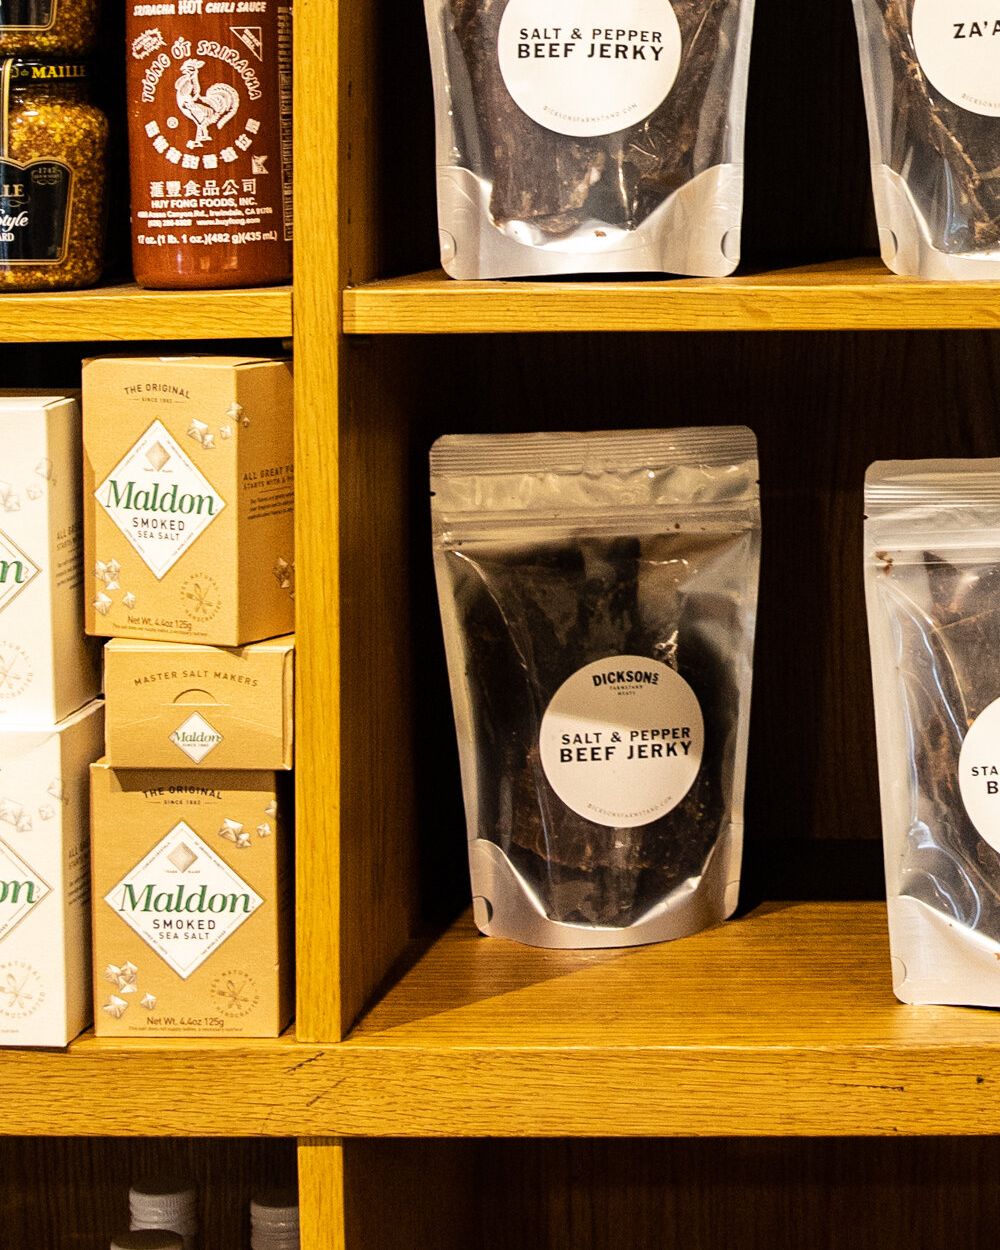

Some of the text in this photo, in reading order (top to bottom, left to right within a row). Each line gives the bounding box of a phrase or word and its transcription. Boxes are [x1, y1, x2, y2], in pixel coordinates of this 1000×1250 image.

[178, 0, 203, 15] HOT
[205, 2, 235, 14] CHILI
[236, 1, 267, 12] SAUCE
[519, 28, 662, 43] SALT & PEPPER
[517, 43, 664, 61] BEEF JERKY
[197, 40, 262, 100] SRIRACHA
[151, 197, 258, 209] HUY FONG FOODS, INC.
[167, 234, 179, 244] lb.
[181, 234, 187, 243] 1
[124, 383, 191, 399] THE ORIGINAL
[243, 467, 283, 481] ALL GREAT
[106, 480, 215, 516] Maldon
[132, 518, 185, 531] SMOKED
[159, 532, 180, 541] SALT
[128, 616, 140, 624] Net
[175, 619, 192, 631] 125g
[134, 670, 258, 687] MASTER SALT MAKERS
[173, 731, 221, 743] Maldon
[561, 727, 691, 745] SALT & PEPPER
[559, 740, 692, 763] BEEF JERKY
[143, 785, 223, 800] THE ORIGINAL
[119, 884, 251, 913] Maldon
[153, 919, 216, 930] SMOKED
[184, 932, 210, 940] SALT
[147, 1017, 224, 1027] Net Wt. 4.4oz 125g
